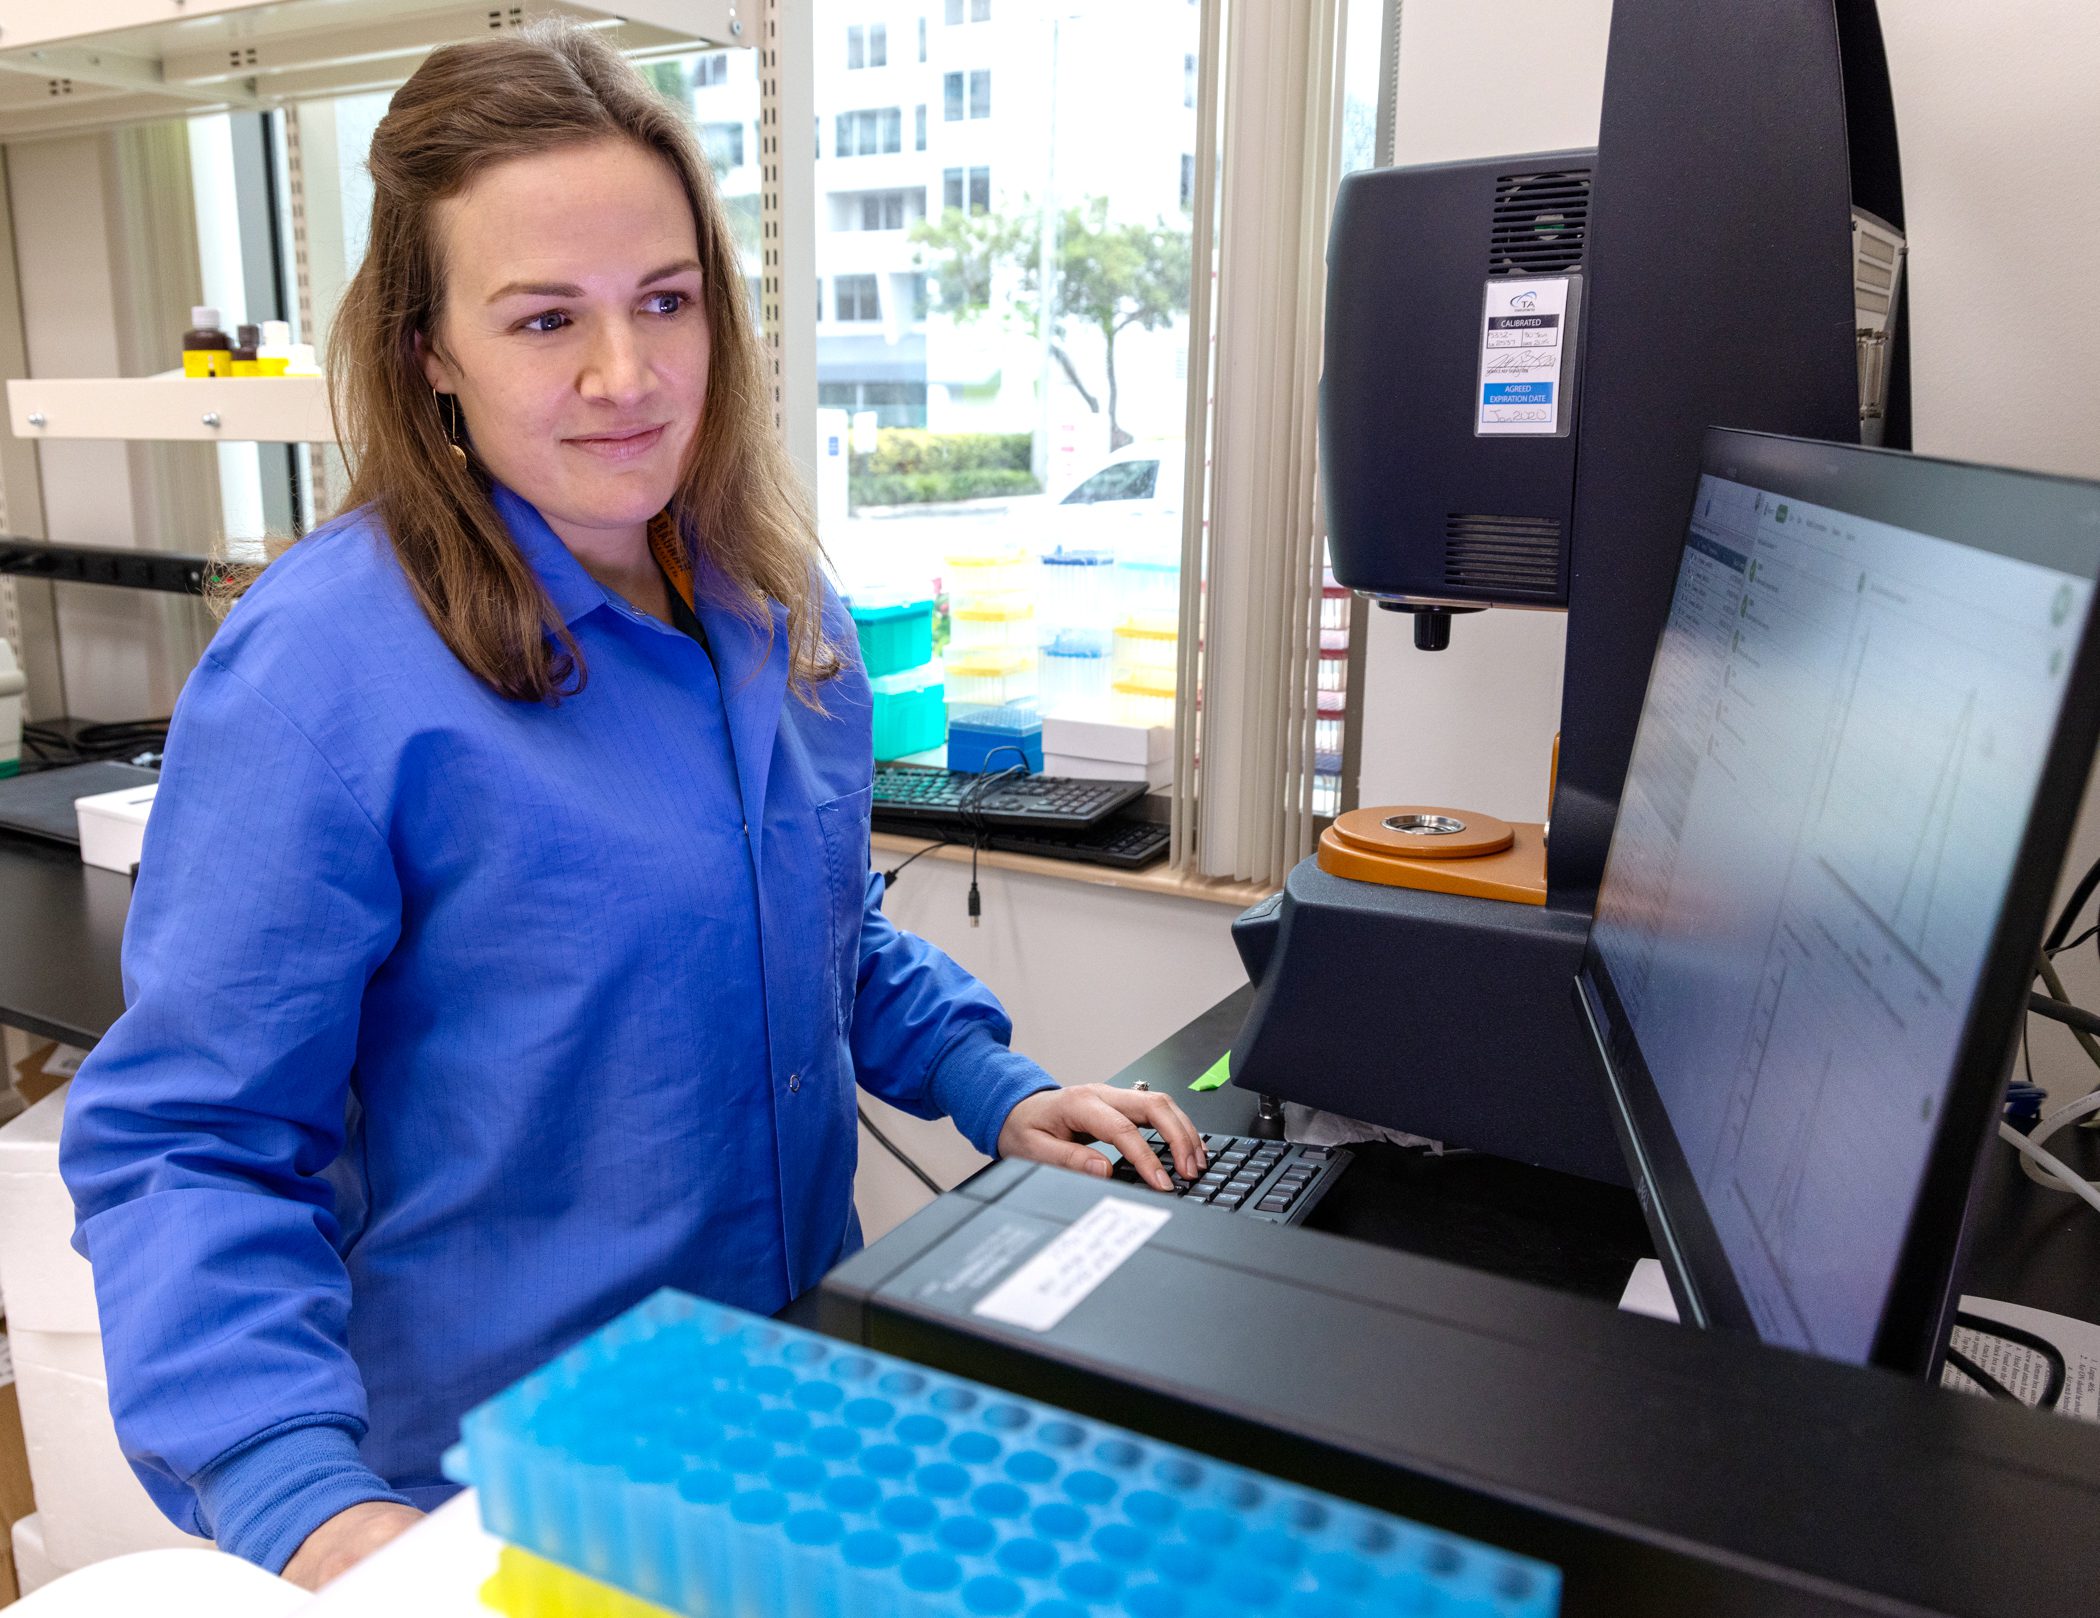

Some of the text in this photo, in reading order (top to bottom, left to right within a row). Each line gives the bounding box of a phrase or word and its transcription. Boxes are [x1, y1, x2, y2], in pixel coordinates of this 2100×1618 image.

[1501, 318, 1541, 328] CALIBRATED
[1504, 385, 1532, 393] AGREED
[1489, 395, 1528, 403] EXPIRATION
